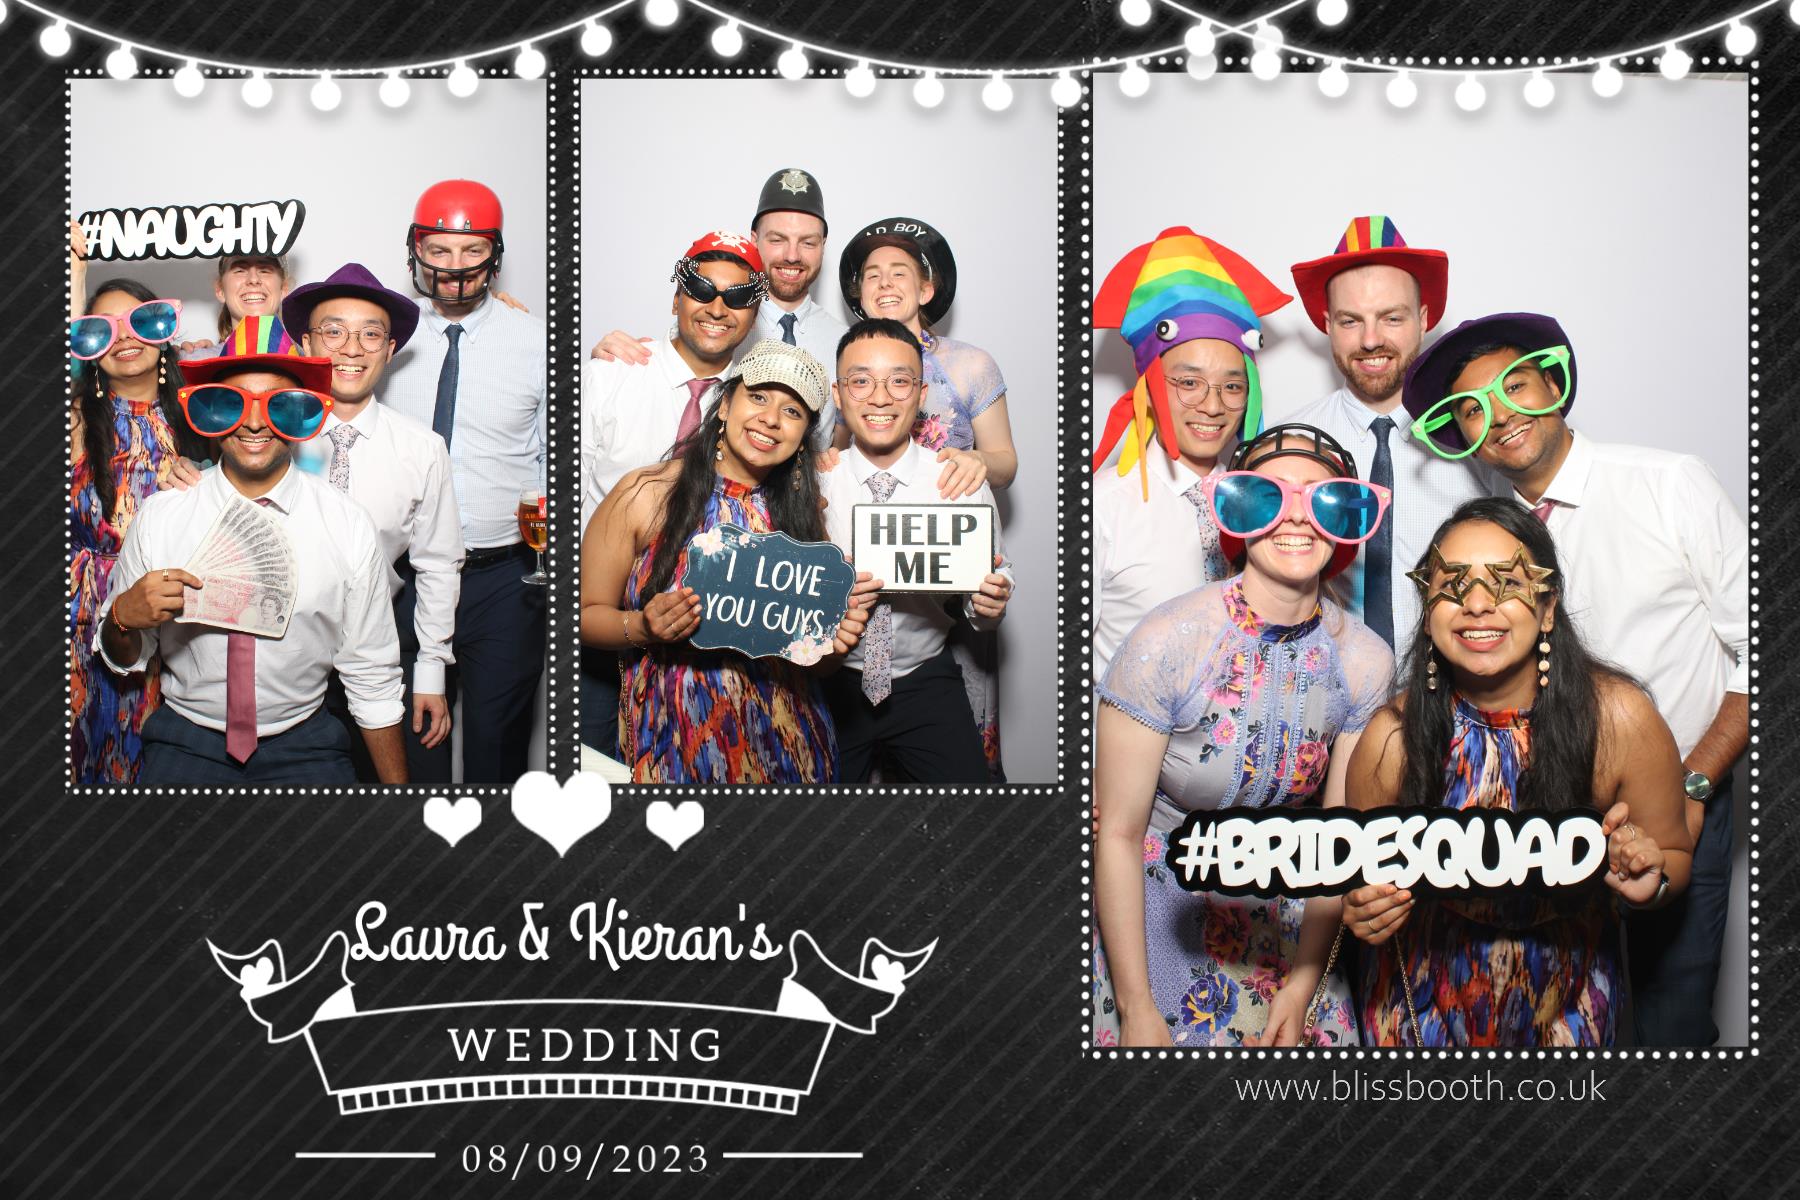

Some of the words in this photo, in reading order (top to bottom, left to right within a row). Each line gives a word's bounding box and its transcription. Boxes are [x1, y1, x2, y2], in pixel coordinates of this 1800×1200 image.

[80, 200, 298, 258] #NAUGHTY
[893, 222, 927, 237] BOY
[869, 513, 978, 546] HELP
[726, 550, 737, 582] I
[755, 556, 826, 597] LOVE
[894, 552, 954, 584] ME
[706, 593, 756, 628] YOU
[762, 601, 825, 639] GUYS
[1175, 815, 1607, 890] #BRIDESQUAD
